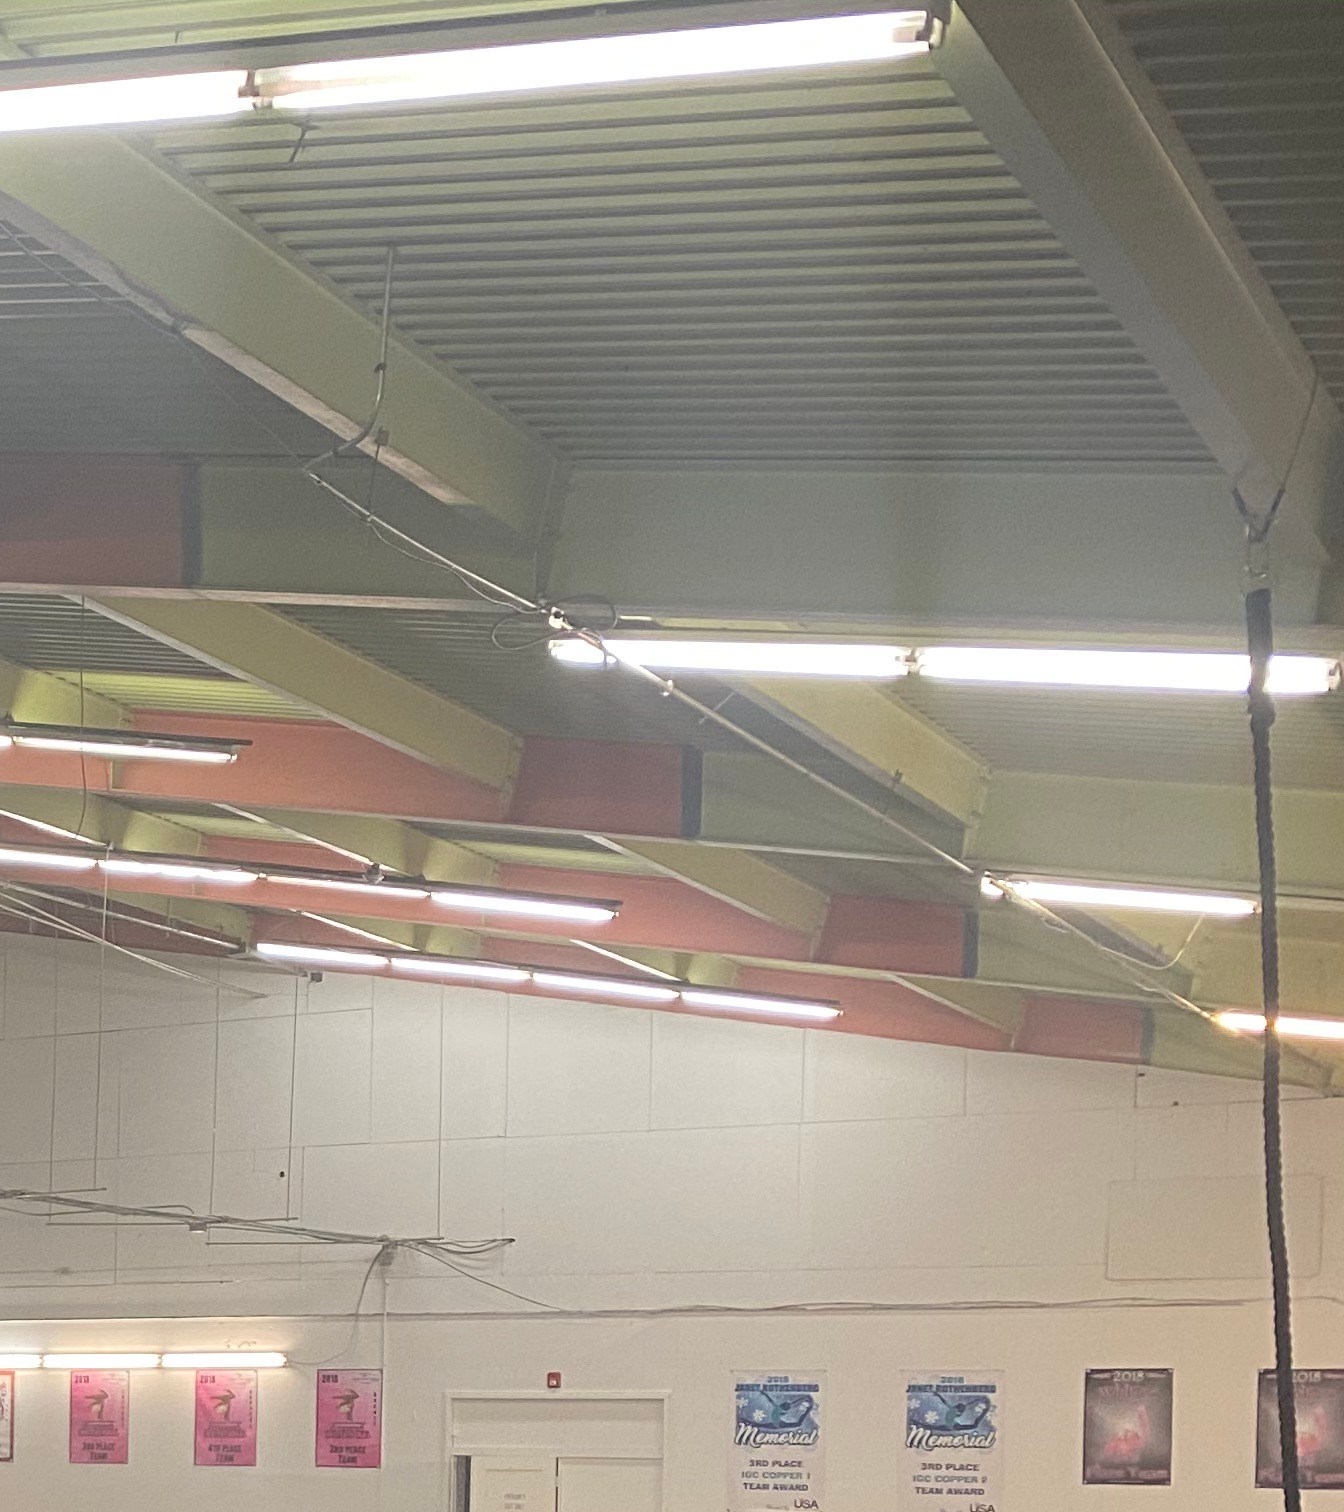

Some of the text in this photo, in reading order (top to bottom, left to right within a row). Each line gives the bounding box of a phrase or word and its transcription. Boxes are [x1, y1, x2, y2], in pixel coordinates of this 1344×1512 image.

[1113, 1370, 1145, 1382] 2018
[735, 1422, 819, 1448] Memorial
[905, 1424, 996, 1451] Memorial
[920, 1463, 980, 1471] 3RD PLACE
[762, 1471, 803, 1480] COPPER
[934, 1475, 978, 1484] COPPER
[743, 1482, 808, 1491] TEAM AWARD
[915, 1486, 985, 1496] TEAM AWARD
[793, 1498, 819, 1510] USA
